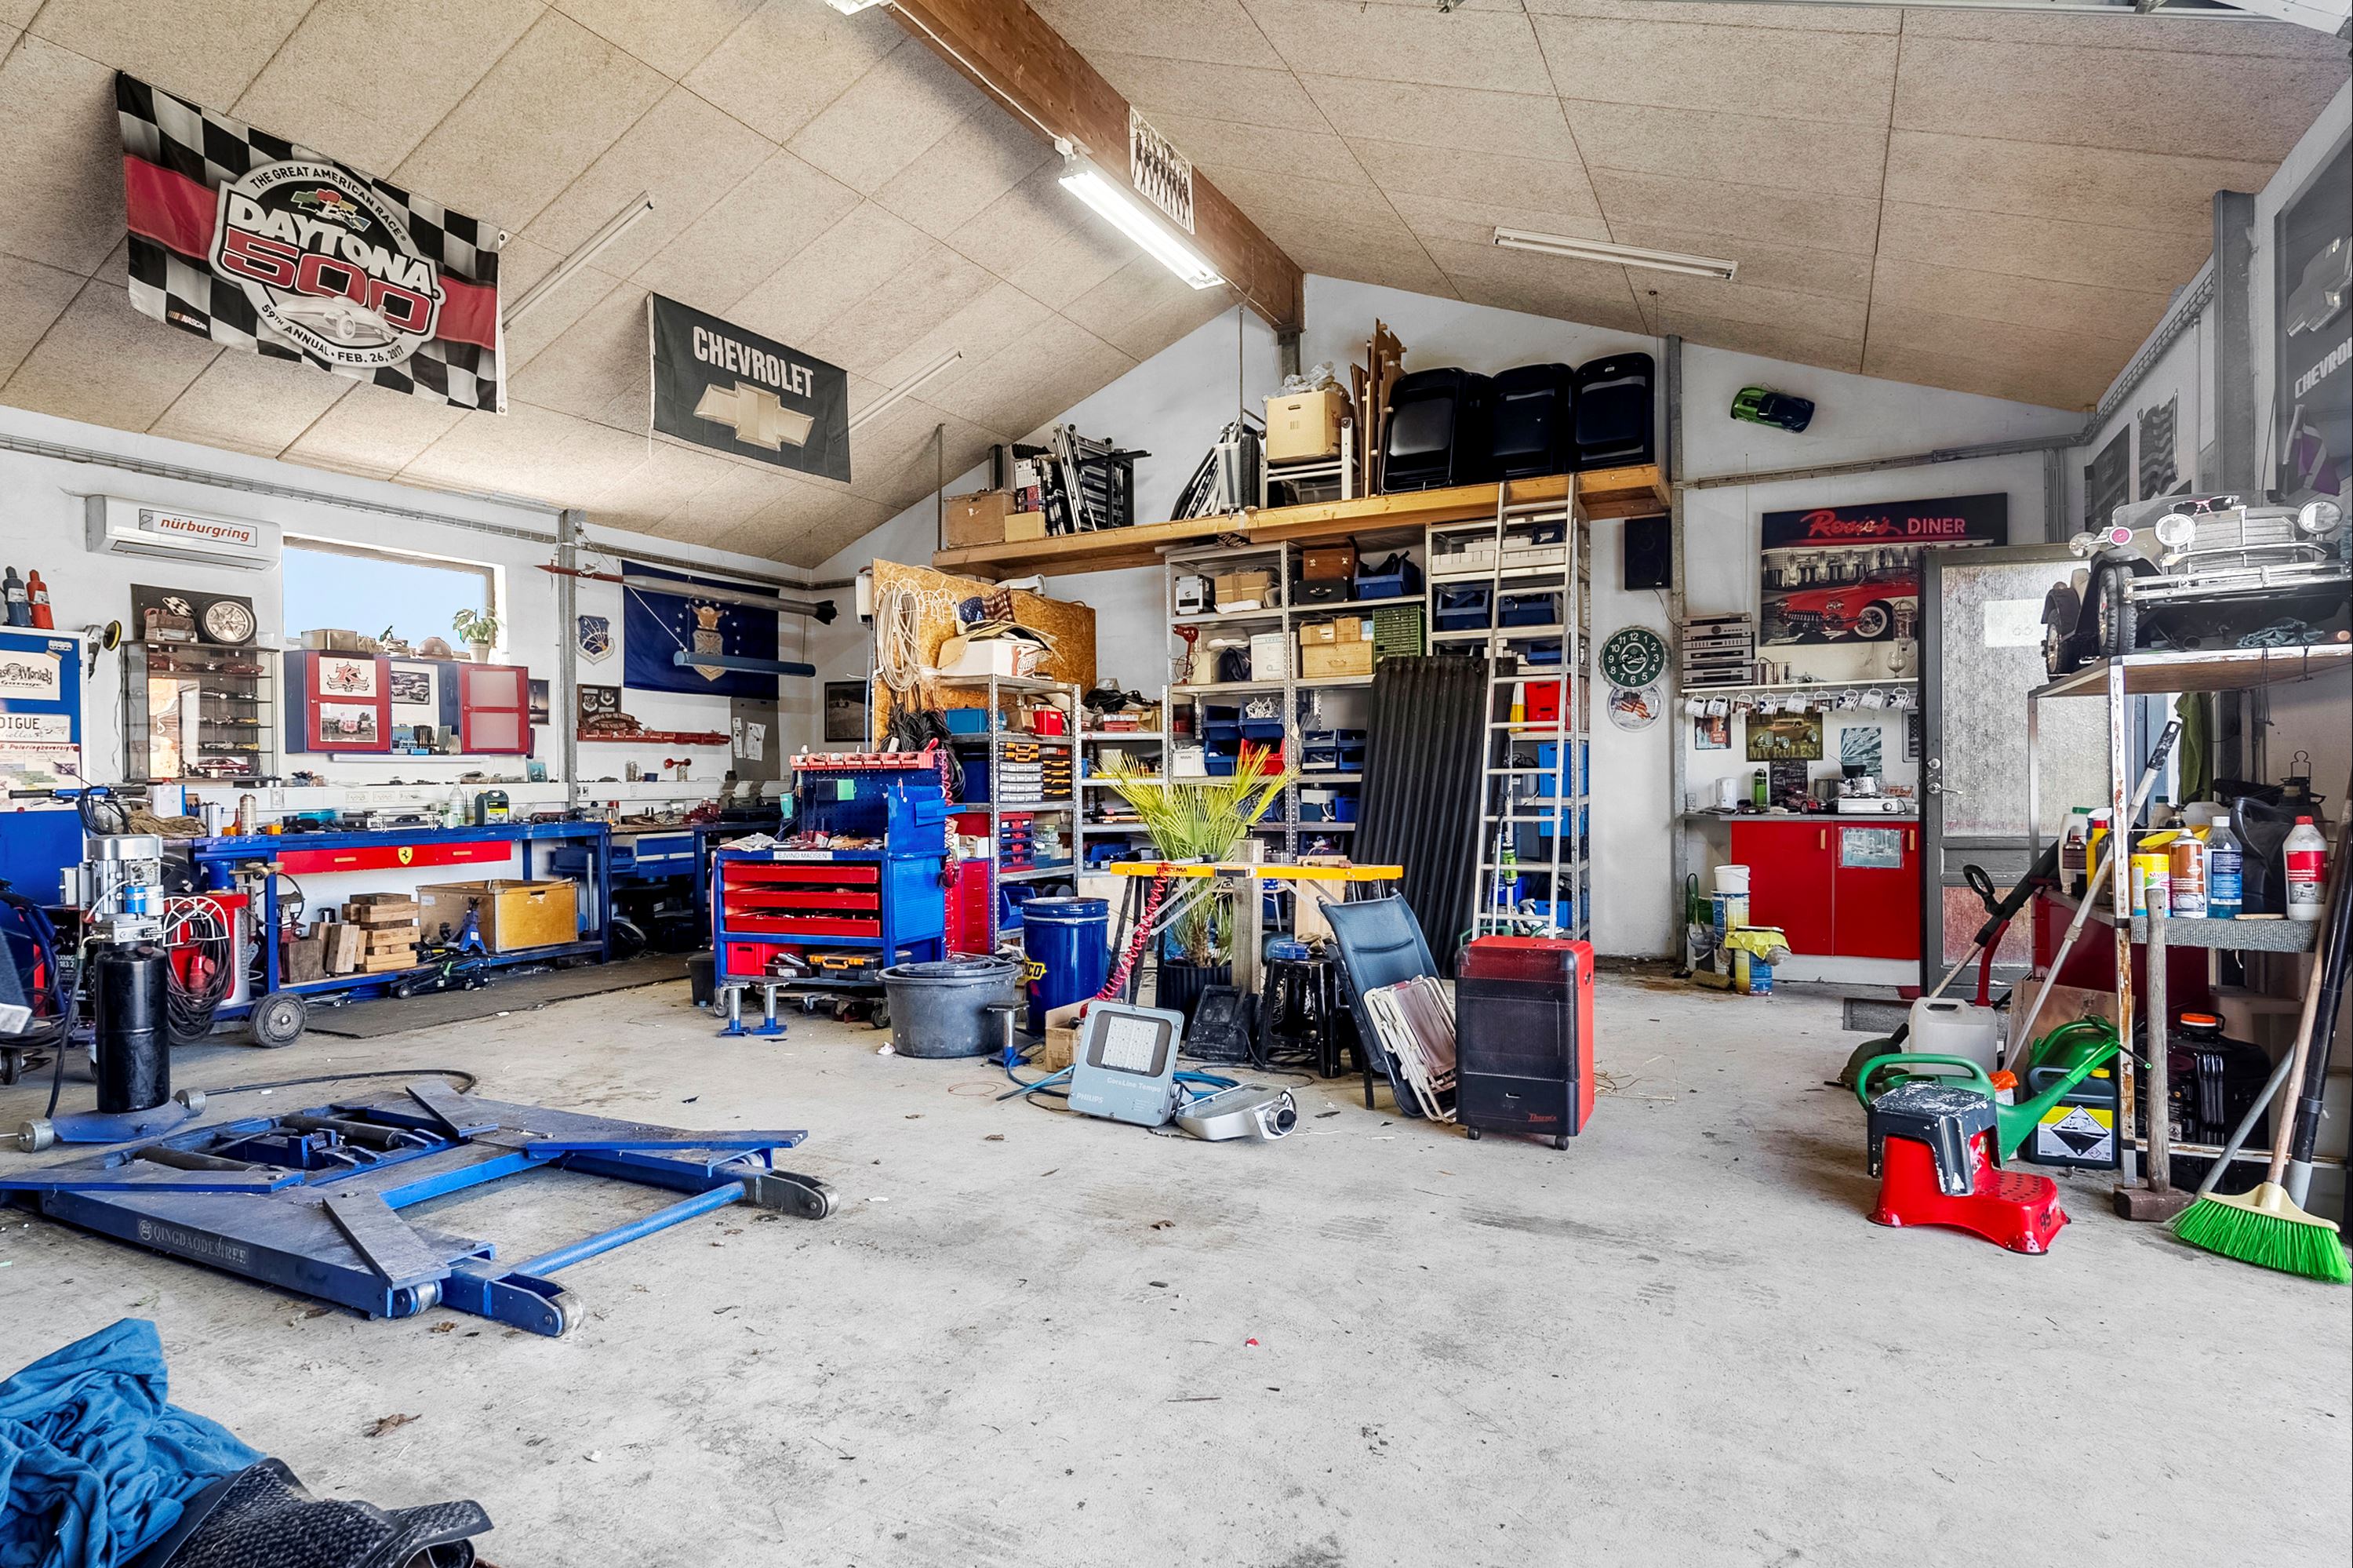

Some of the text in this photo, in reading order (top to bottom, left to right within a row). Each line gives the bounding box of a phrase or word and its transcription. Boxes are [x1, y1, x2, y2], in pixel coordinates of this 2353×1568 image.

[249, 172, 274, 190] THE
[272, 166, 310, 179] GREAT
[313, 168, 374, 207] AMERICAN
[227, 193, 431, 293] DAYTONA
[222, 226, 432, 333] 500
[181, 315, 208, 331] NASCAR
[261, 304, 404, 363] 59TH ANNUAL FEB. 26, 2017
[693, 326, 814, 398] CHEVROLET
[2295, 337, 2352, 398] CHEVROL
[160, 518, 250, 542] nürburgring
[1907, 518, 1966, 534] DINER
[1749, 744, 1820, 759] MY RULES!
[1076, 1092, 1104, 1104] PHILIPS
[1139, 1082, 1162, 1093] Tempo
[154, 1226, 247, 1264] QINGDAODESIREE
